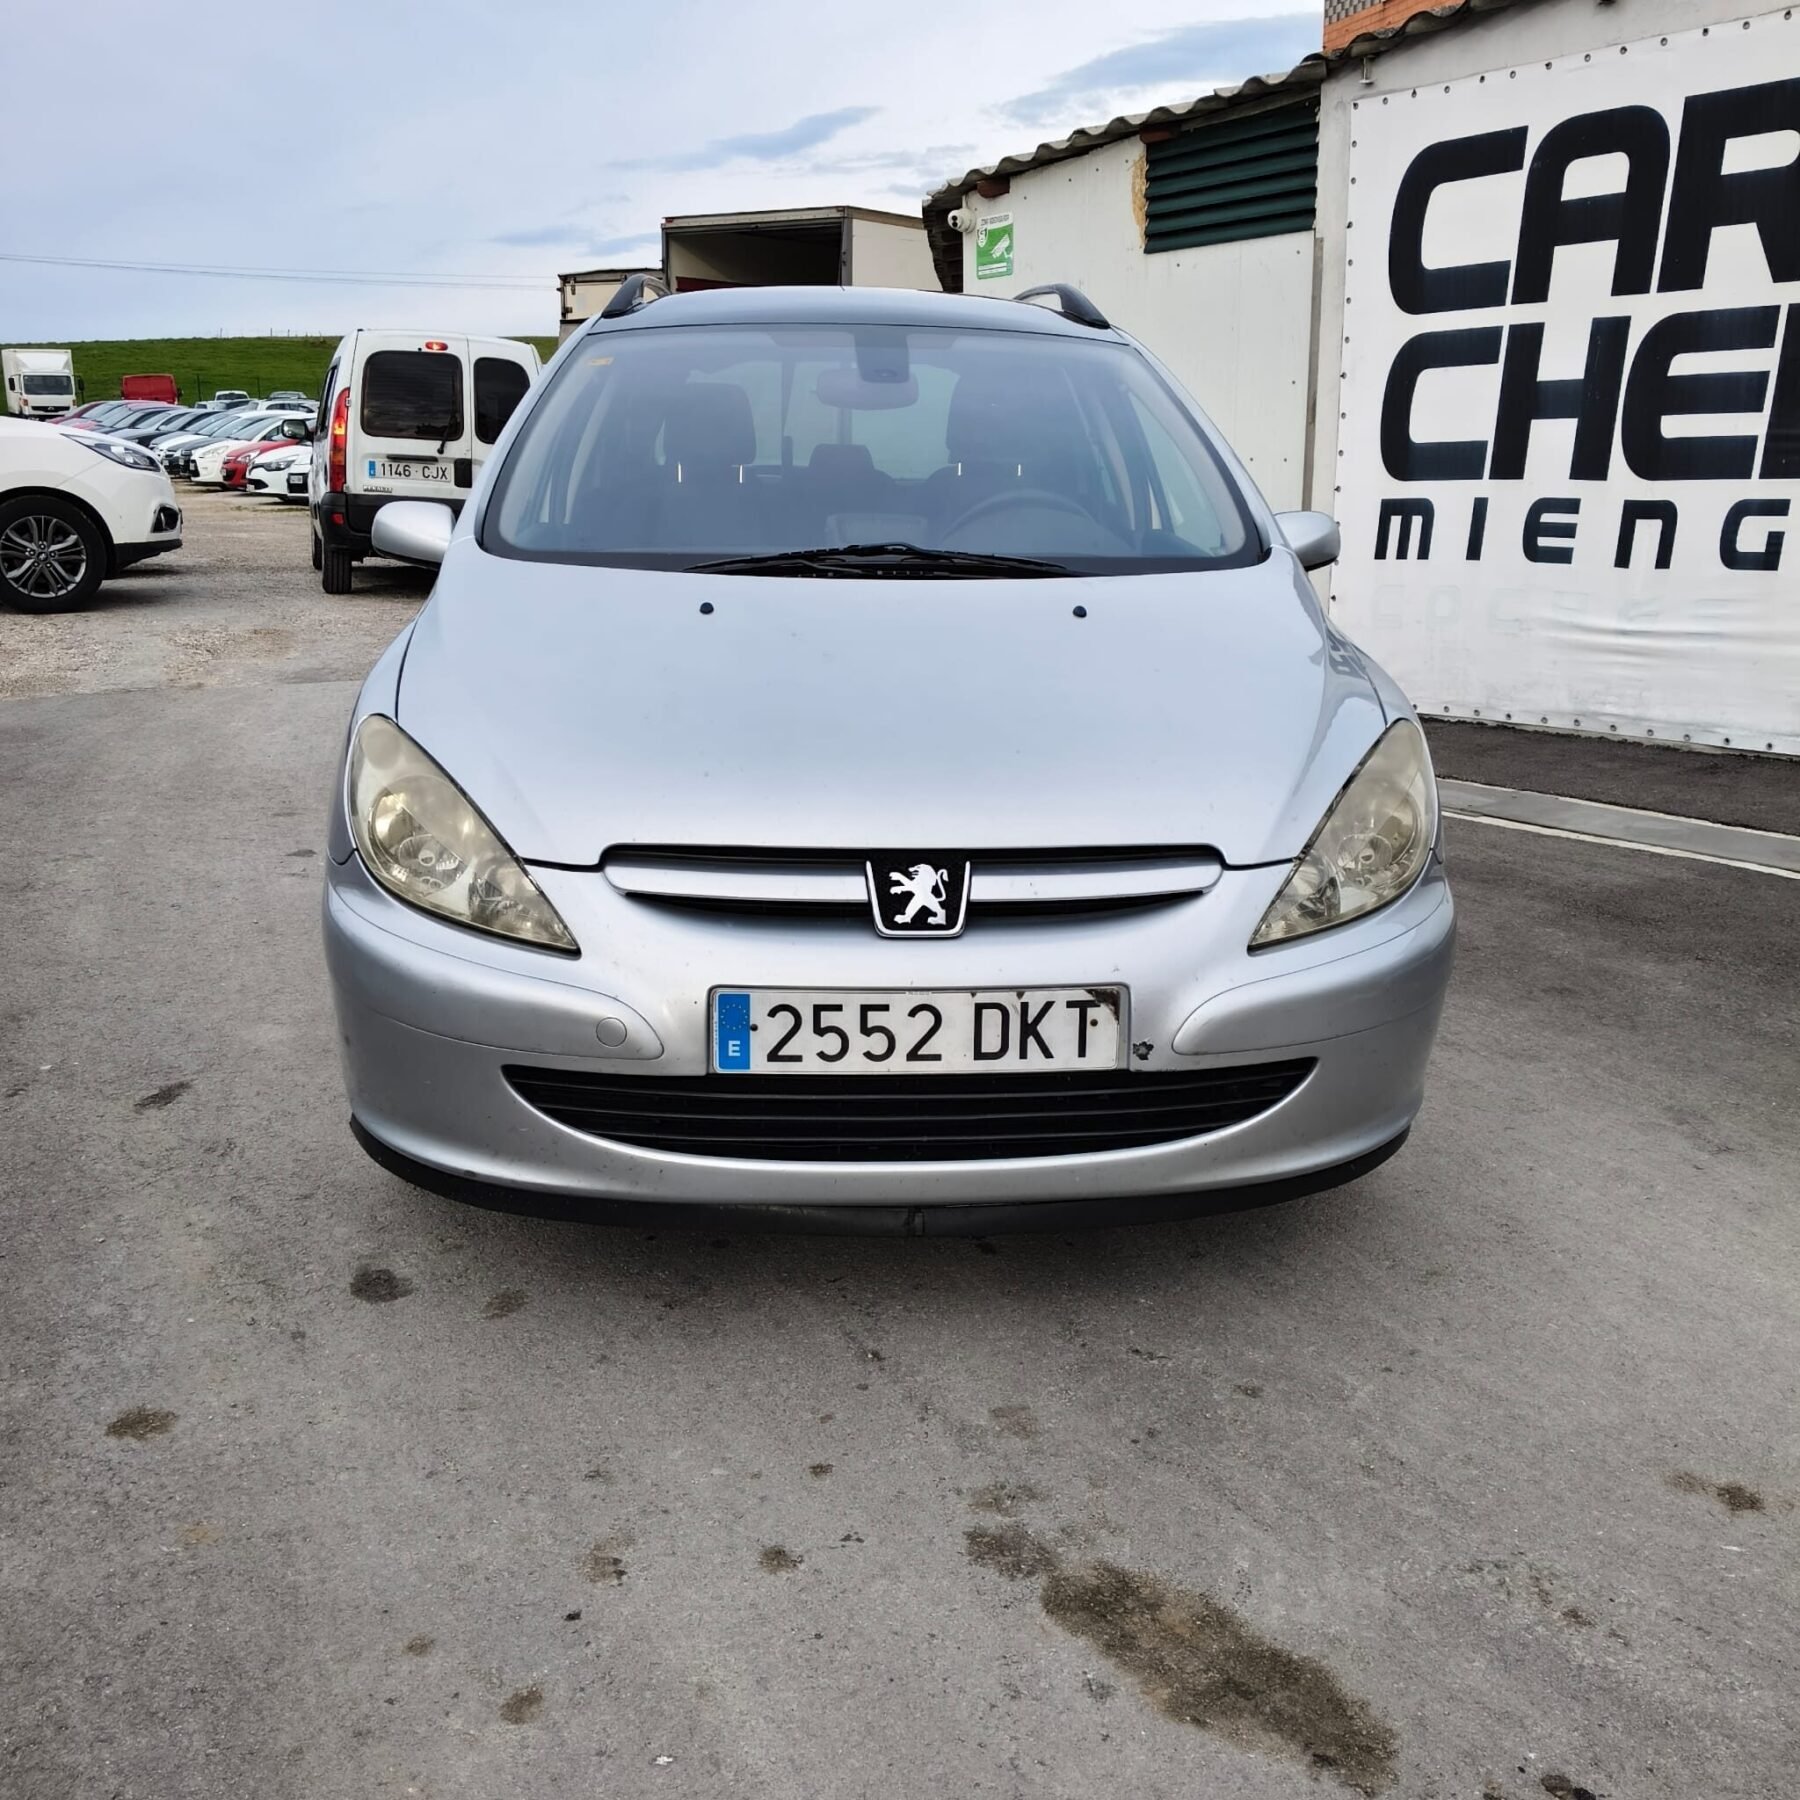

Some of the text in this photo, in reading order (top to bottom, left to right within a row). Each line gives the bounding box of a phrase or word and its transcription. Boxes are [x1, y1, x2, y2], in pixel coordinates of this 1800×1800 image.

[1389, 77, 1800, 315] CAR
[381, 462, 448, 480] 1146 CJX
[728, 1040, 741, 1057] E
[766, 1003, 943, 1063] 2552
[973, 1001, 1101, 1061] DKT
